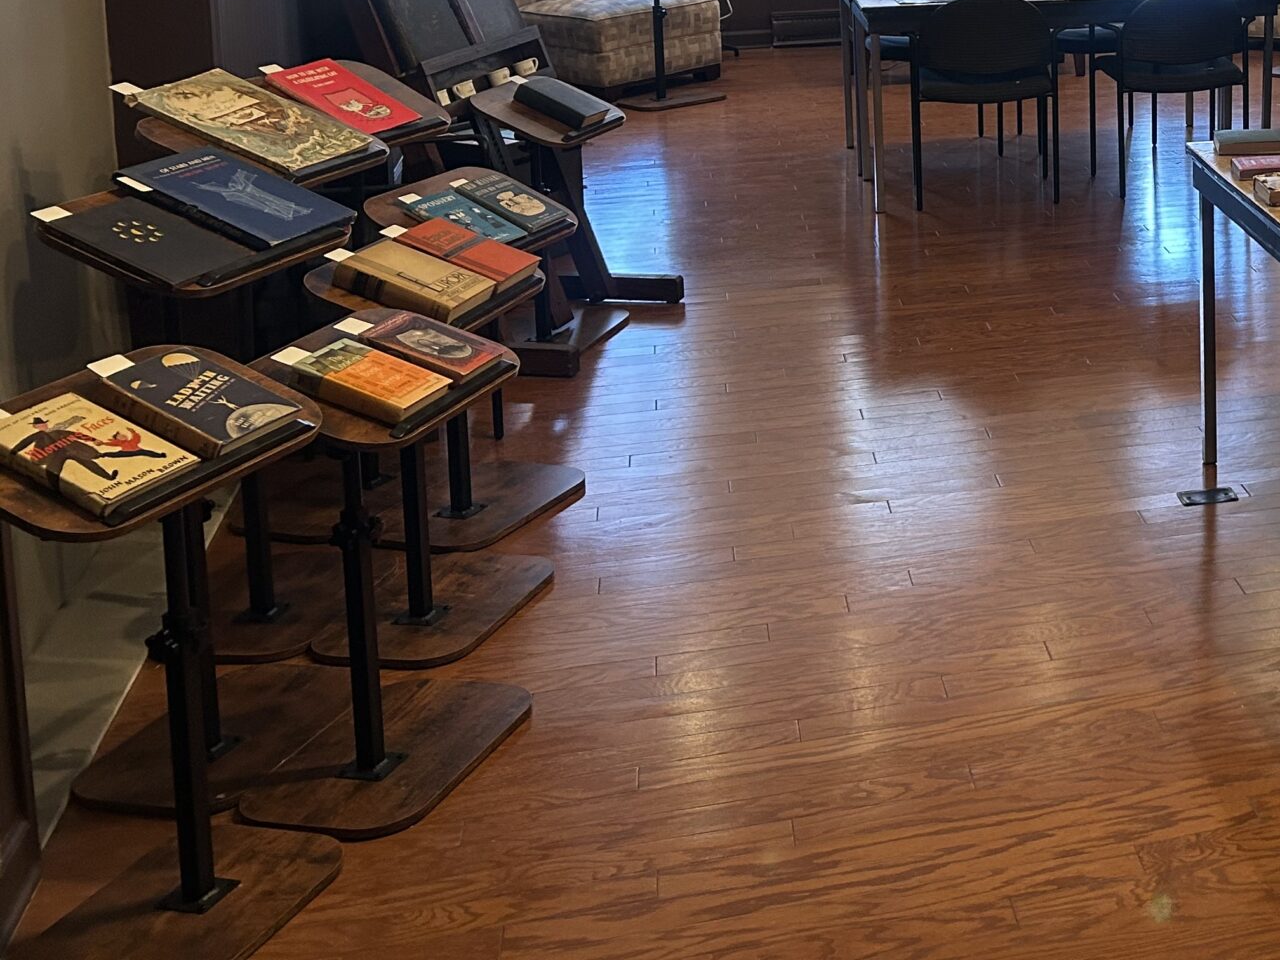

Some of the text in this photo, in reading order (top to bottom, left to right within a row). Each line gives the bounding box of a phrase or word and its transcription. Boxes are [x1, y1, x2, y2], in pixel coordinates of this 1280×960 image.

[178, 374, 230, 410] WAITING
[25, 415, 115, 461] Morning Faces
[100, 455, 189, 495] JOHN MASON BROWN
